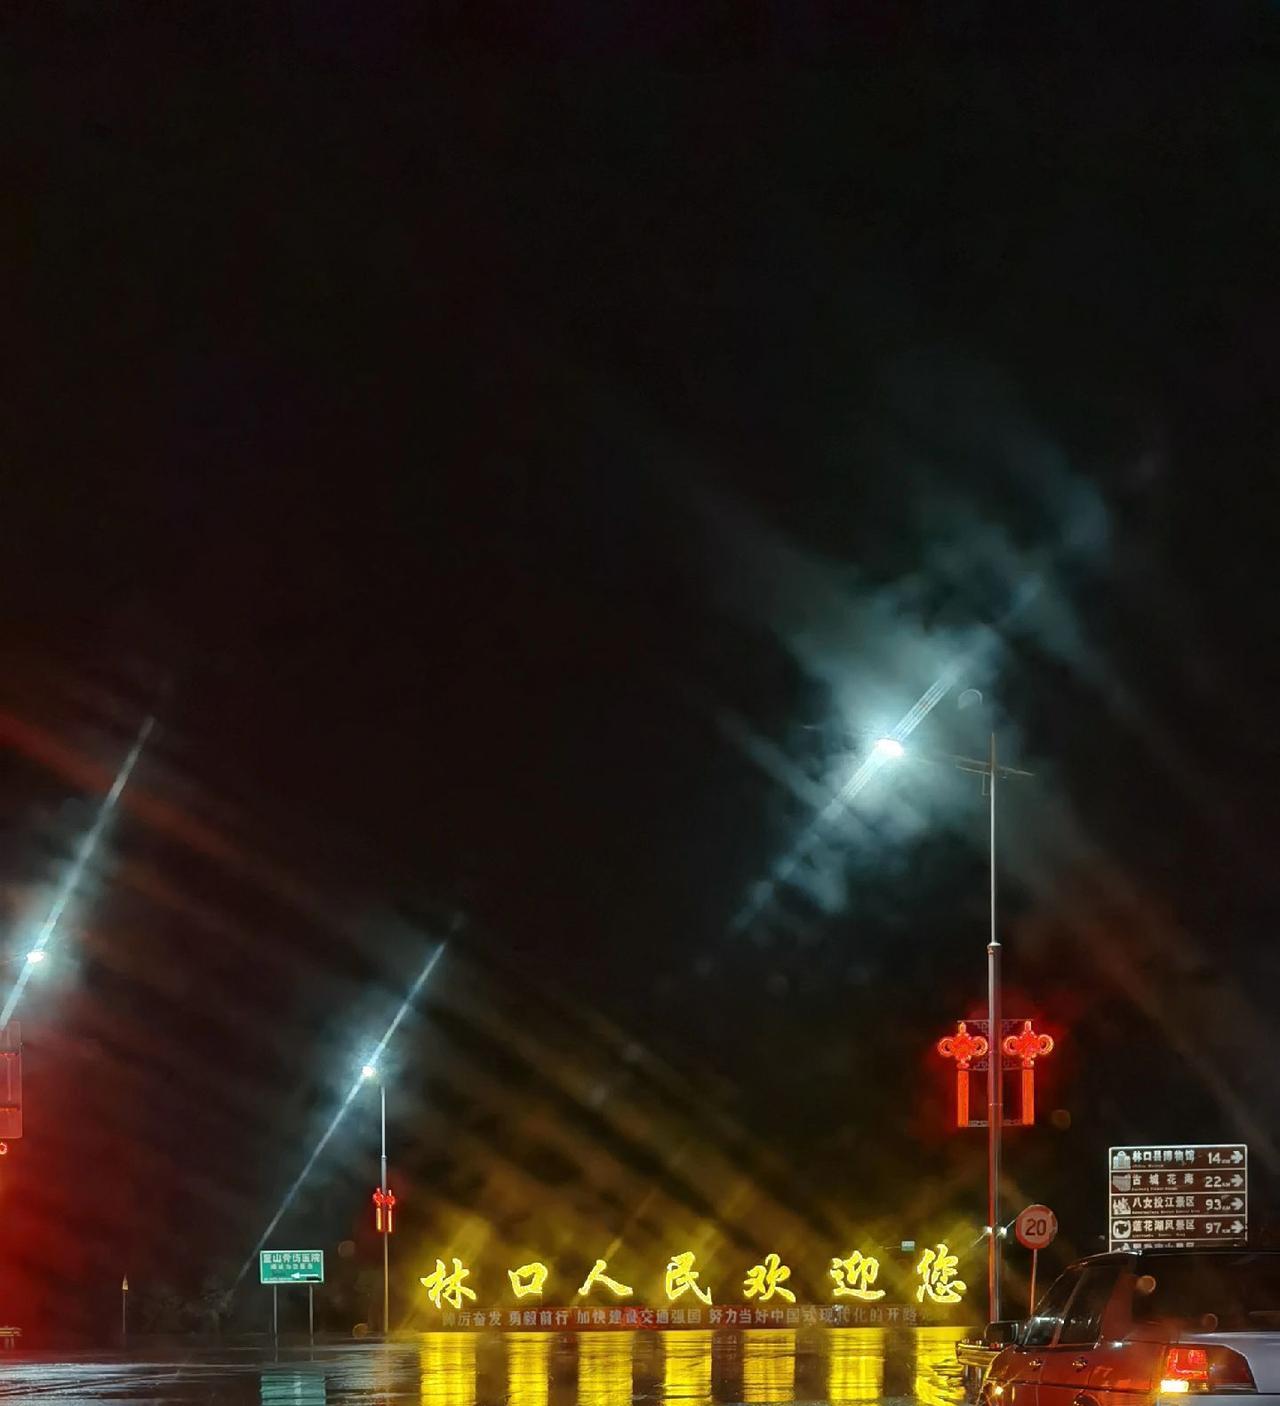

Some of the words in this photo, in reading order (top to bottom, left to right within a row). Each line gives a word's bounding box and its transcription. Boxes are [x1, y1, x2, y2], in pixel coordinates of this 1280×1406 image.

[1132, 1196, 1195, 1208] 八女投江景区
[1025, 1218, 1047, 1236] 20
[420, 1243, 967, 1309] 林口人民欢迎您
